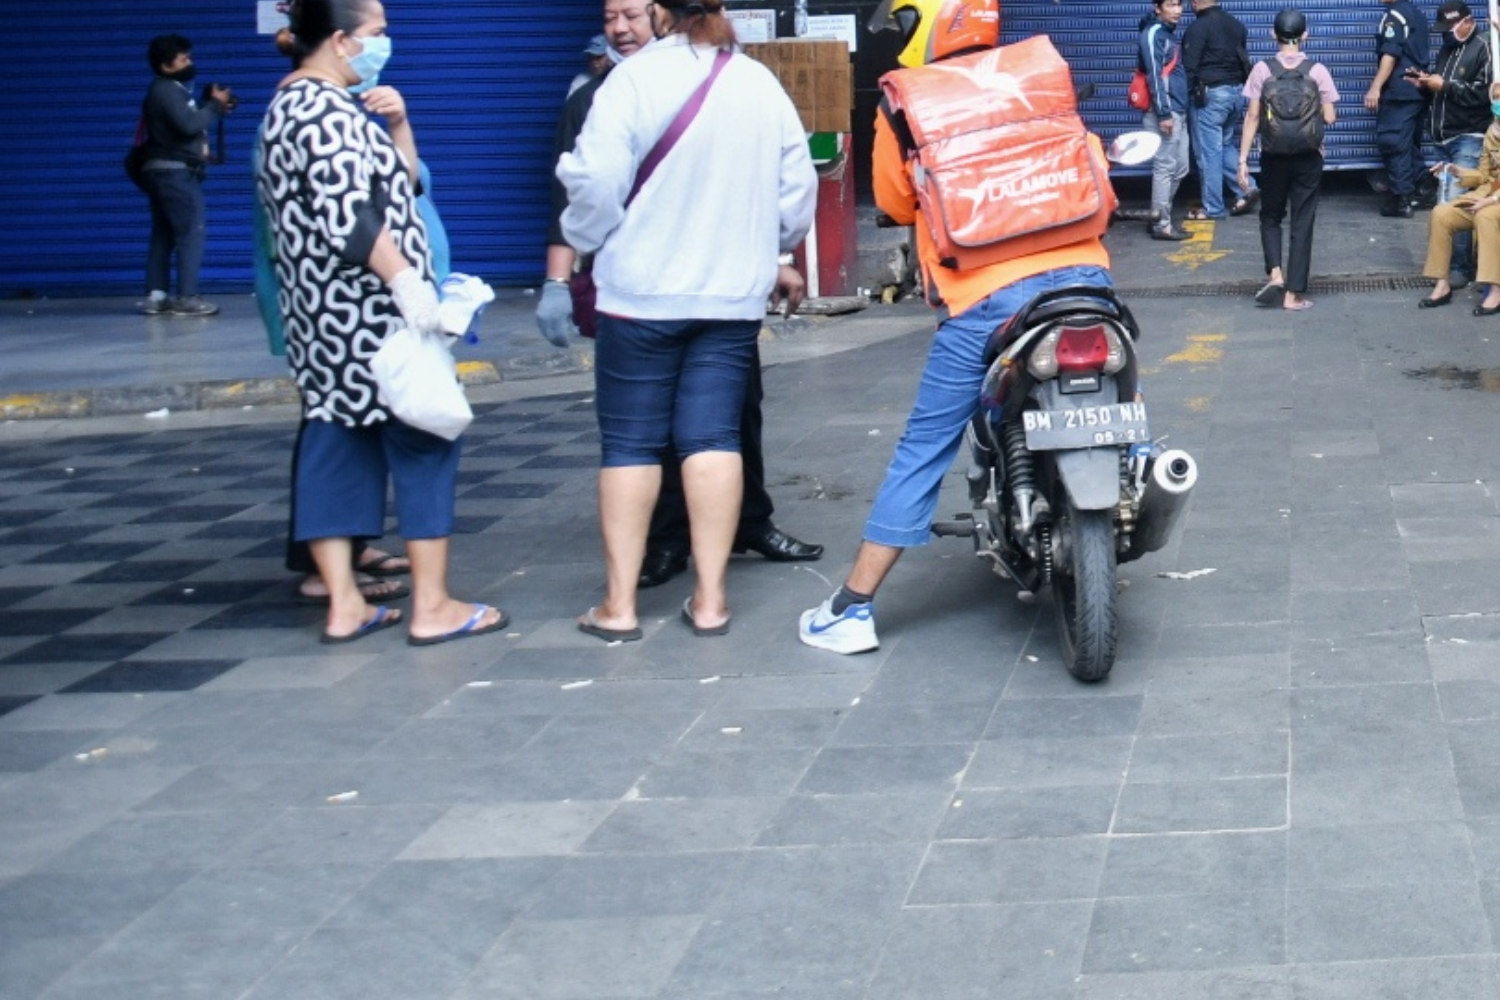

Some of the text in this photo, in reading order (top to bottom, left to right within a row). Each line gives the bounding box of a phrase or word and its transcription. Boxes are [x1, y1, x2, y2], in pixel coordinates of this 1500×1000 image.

[988, 167, 1079, 203] LALAMOVE
[1023, 403, 1147, 431] BM 2150 NH
